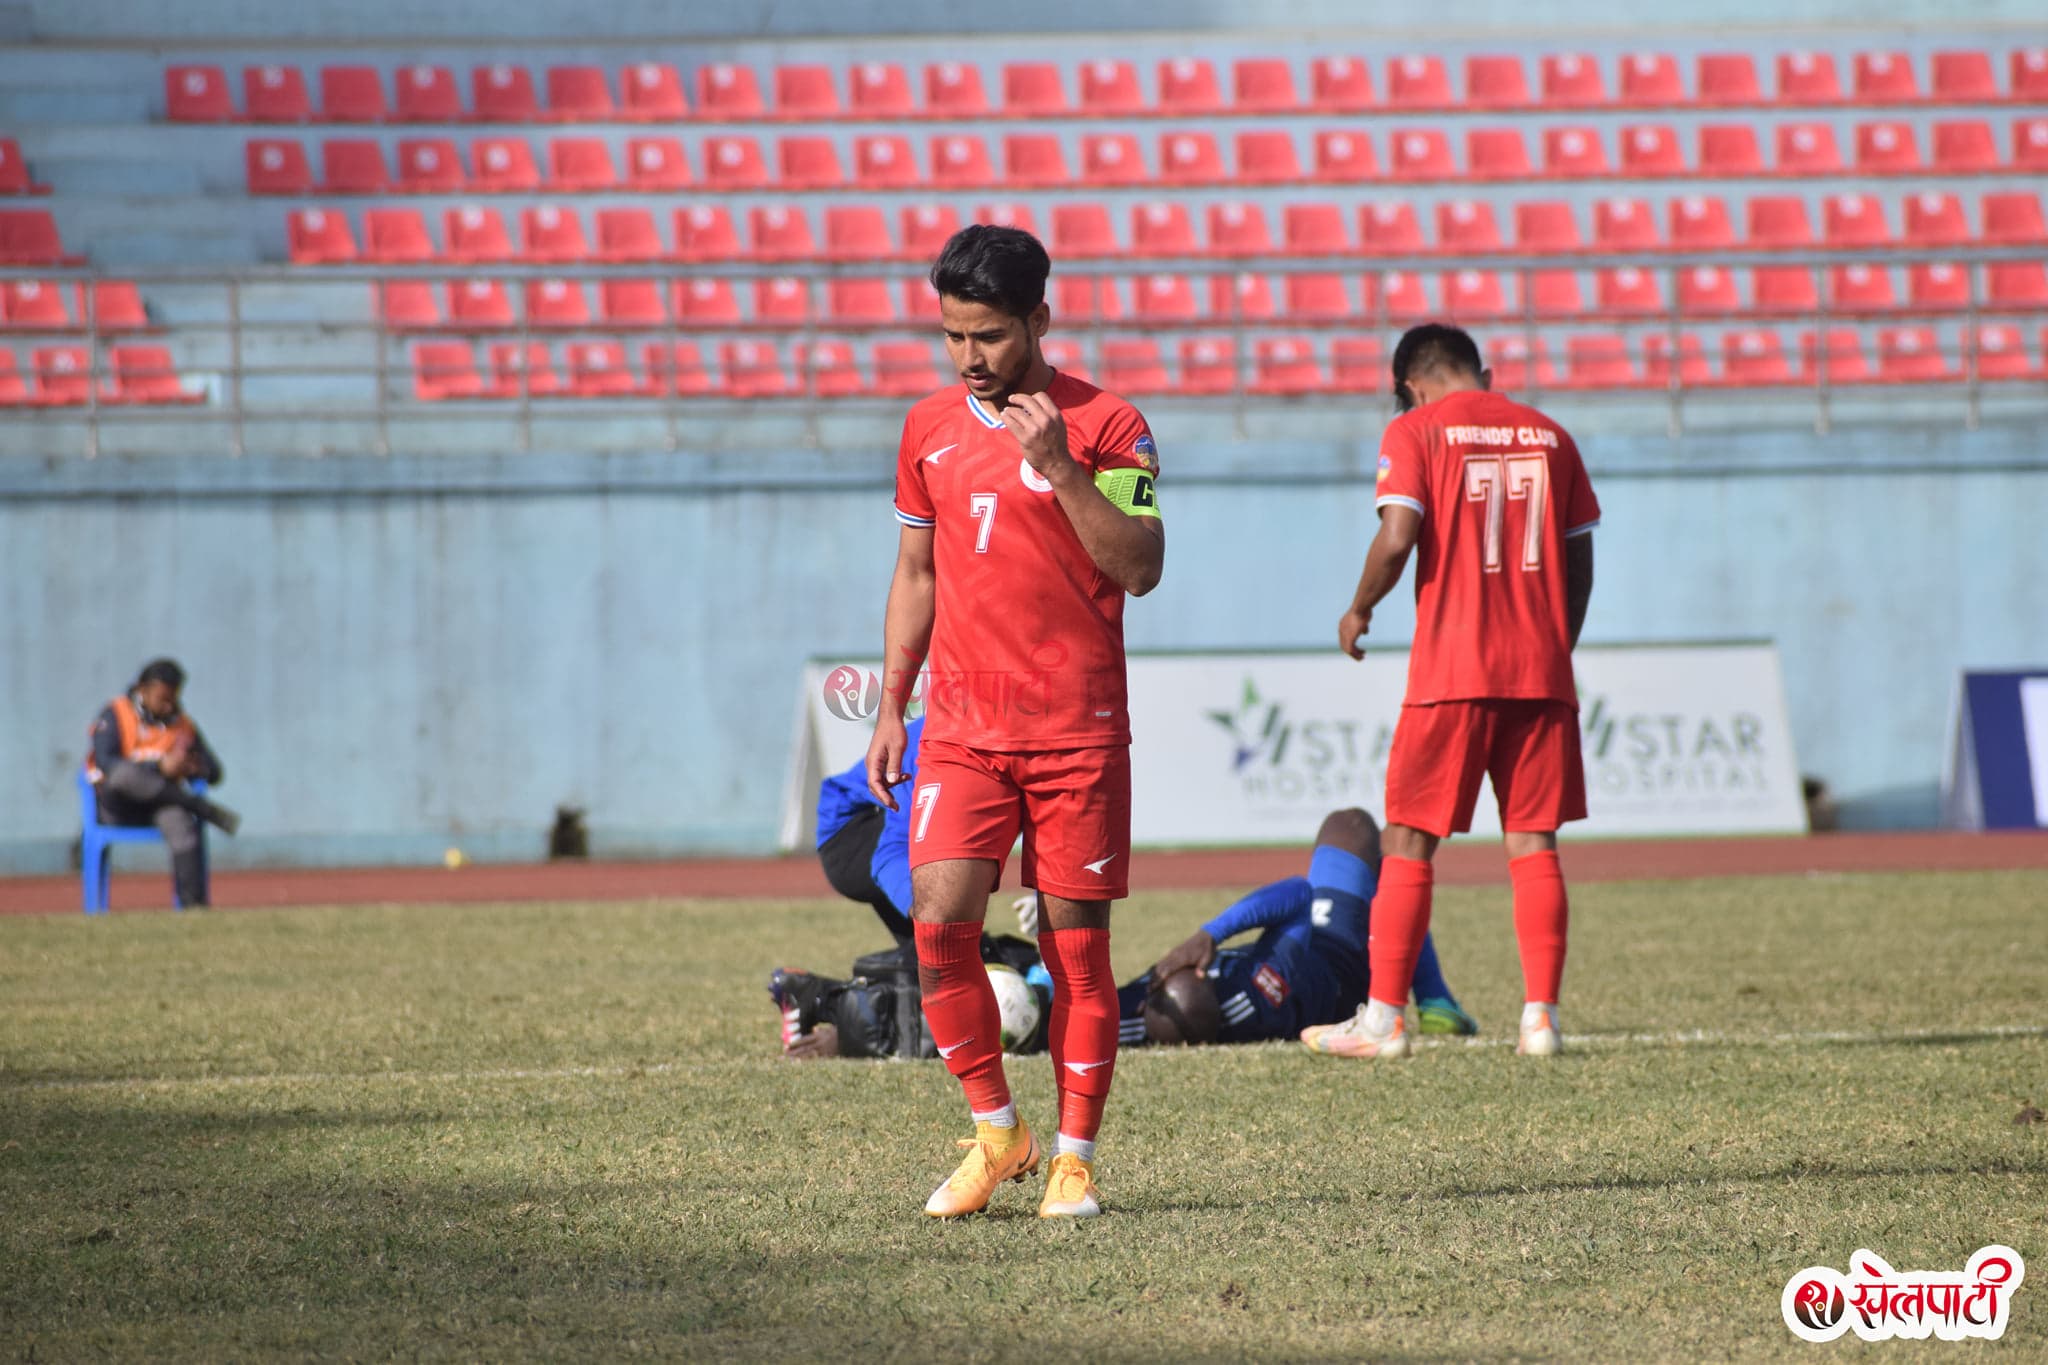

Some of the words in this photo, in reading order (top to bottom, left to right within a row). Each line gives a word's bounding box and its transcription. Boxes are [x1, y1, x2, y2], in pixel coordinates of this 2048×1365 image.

[1445, 425, 1514, 446] FRIENDS'
[1517, 426, 1558, 448] CLUB
[1131, 475, 1154, 507] C
[1463, 451, 1550, 573] 77
[970, 493, 998, 553] 7
[1301, 720, 1394, 767] STA
[1626, 712, 1764, 762] STAR
[1590, 763, 1768, 795] OSPITAL
[915, 783, 941, 843] 7
